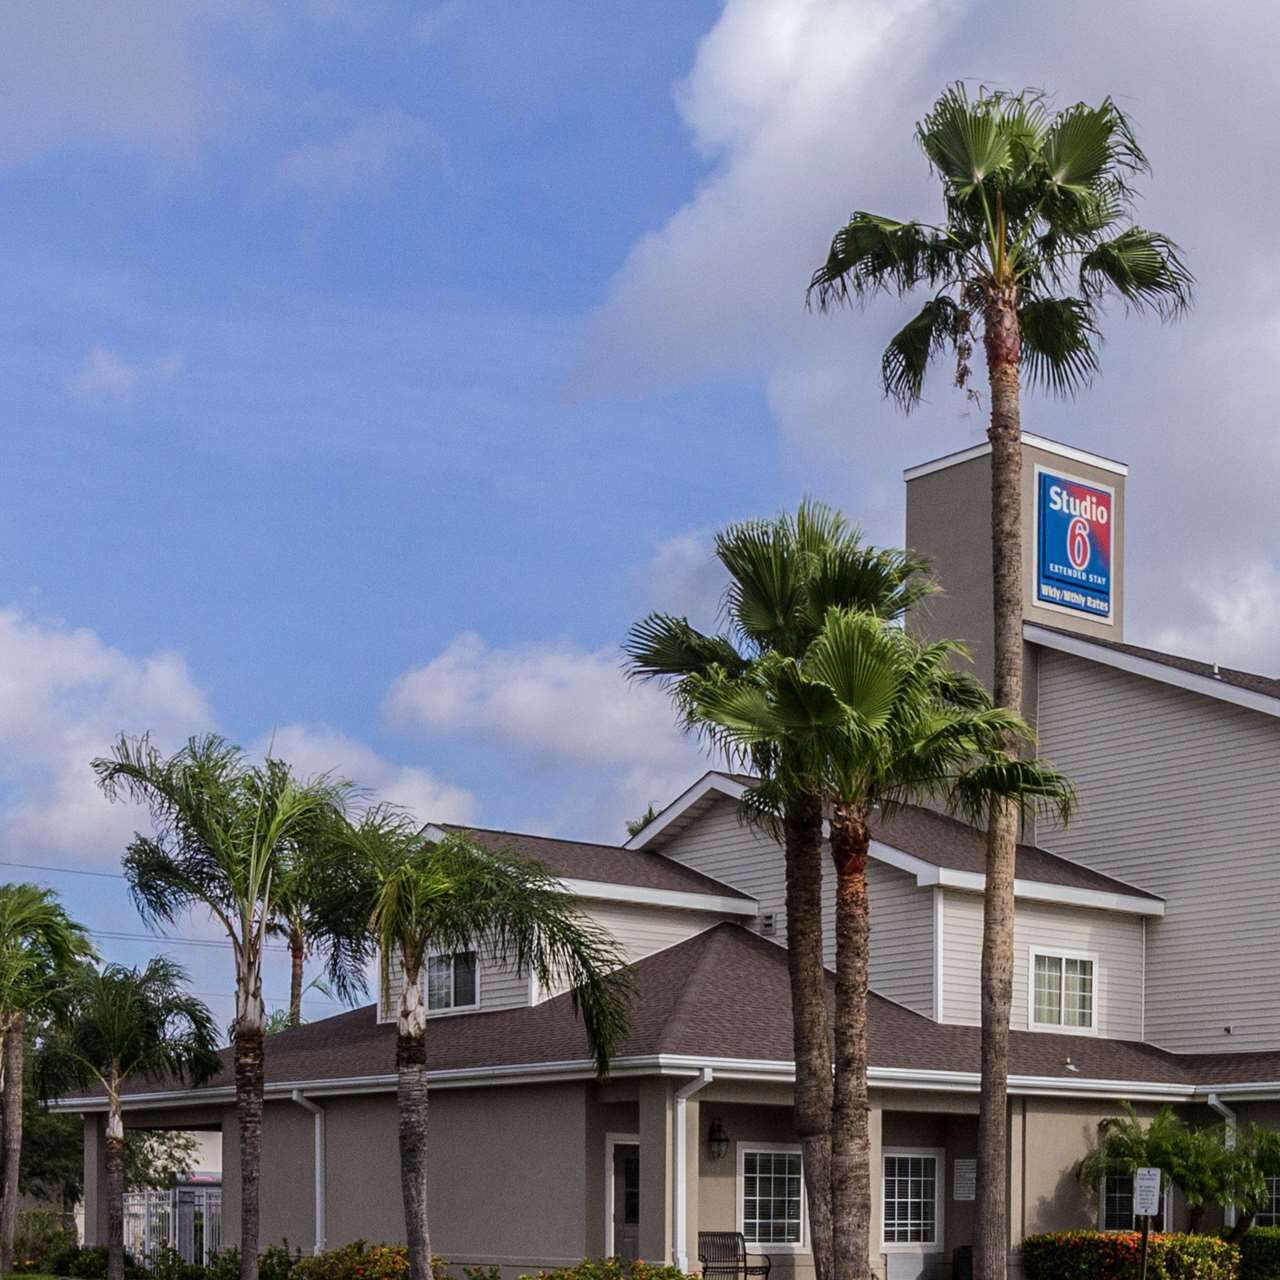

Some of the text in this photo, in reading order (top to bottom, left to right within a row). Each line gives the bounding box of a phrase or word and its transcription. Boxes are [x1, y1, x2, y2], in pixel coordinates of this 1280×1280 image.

[1049, 485, 1108, 524] Studio
[1067, 517, 1091, 570] 6
[1050, 563, 1107, 585] EXTENDED STAY
[1086, 596, 1109, 612] Rates
